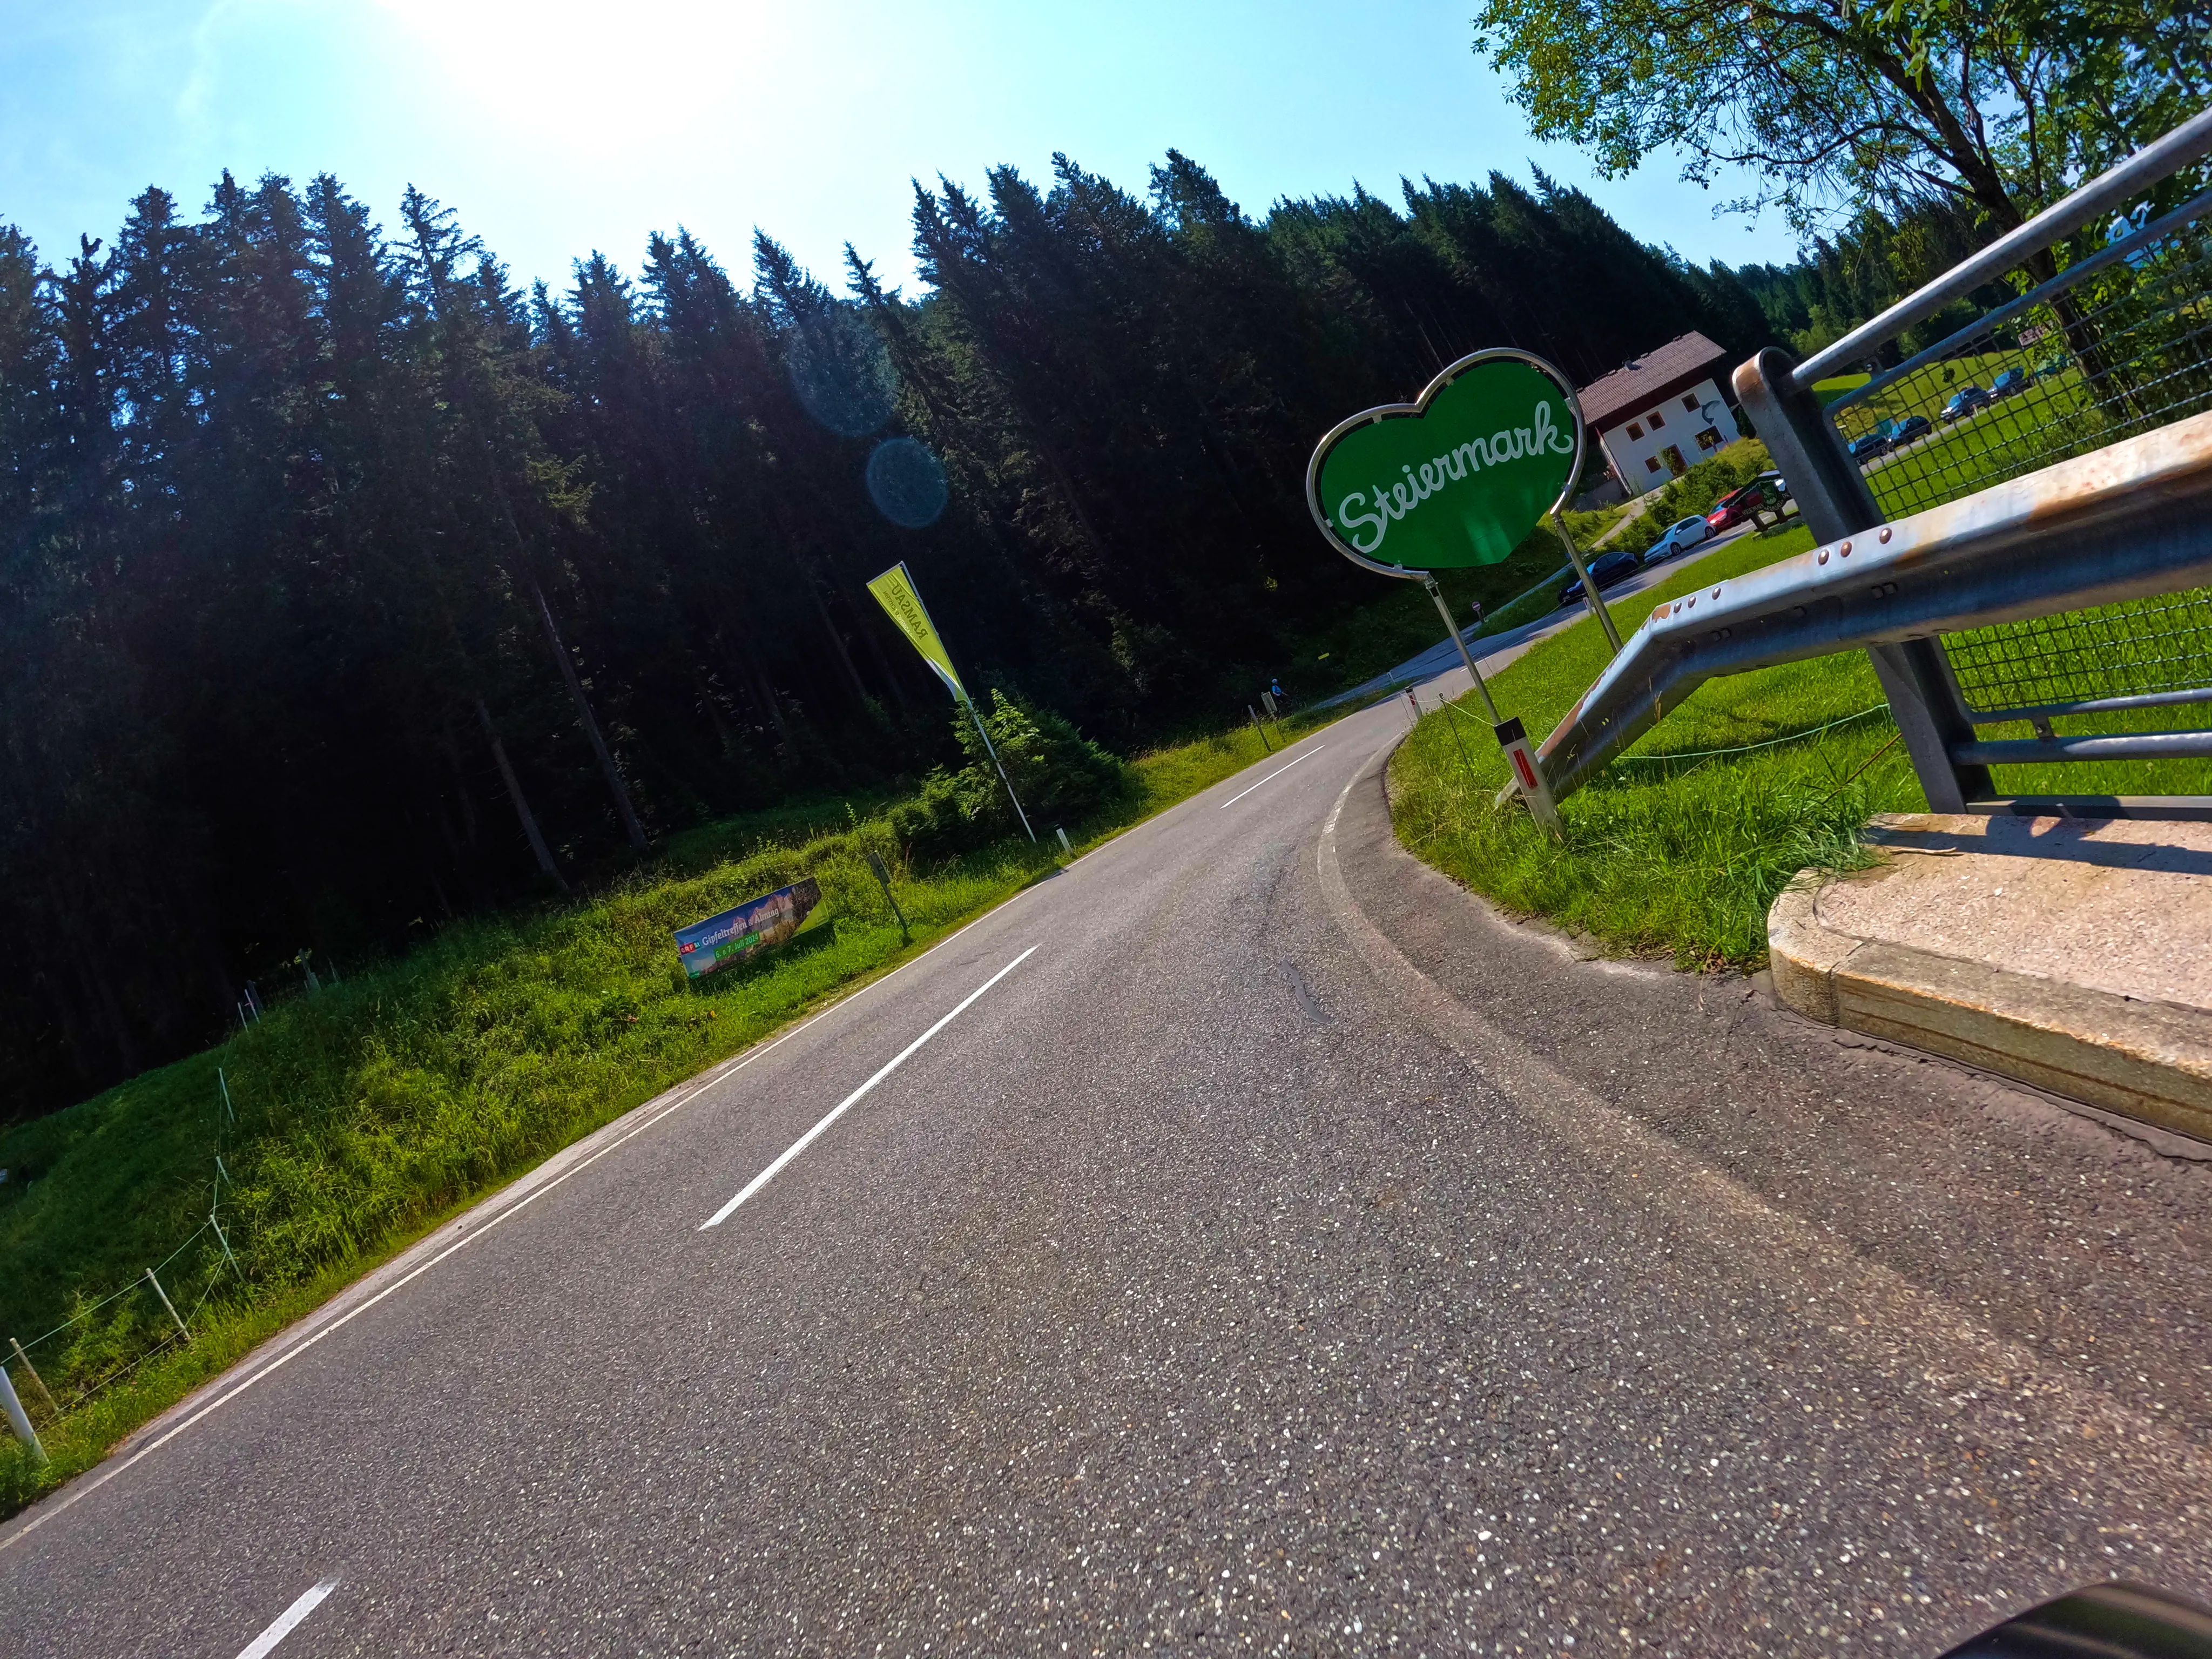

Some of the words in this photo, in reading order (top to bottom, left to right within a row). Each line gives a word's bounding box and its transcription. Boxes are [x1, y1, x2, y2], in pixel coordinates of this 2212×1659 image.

[1339, 401, 1574, 554] Steiermark
[702, 922, 747, 946] Gipfeltreffen
[748, 919, 753, 927] &
[754, 908, 779, 923] Almtag
[680, 943, 694, 953] ORF
[715, 950, 721, 959] 6.
[727, 945, 734, 953] 7.
[734, 939, 745, 950] Juli
[745, 933, 759, 945] 2024
